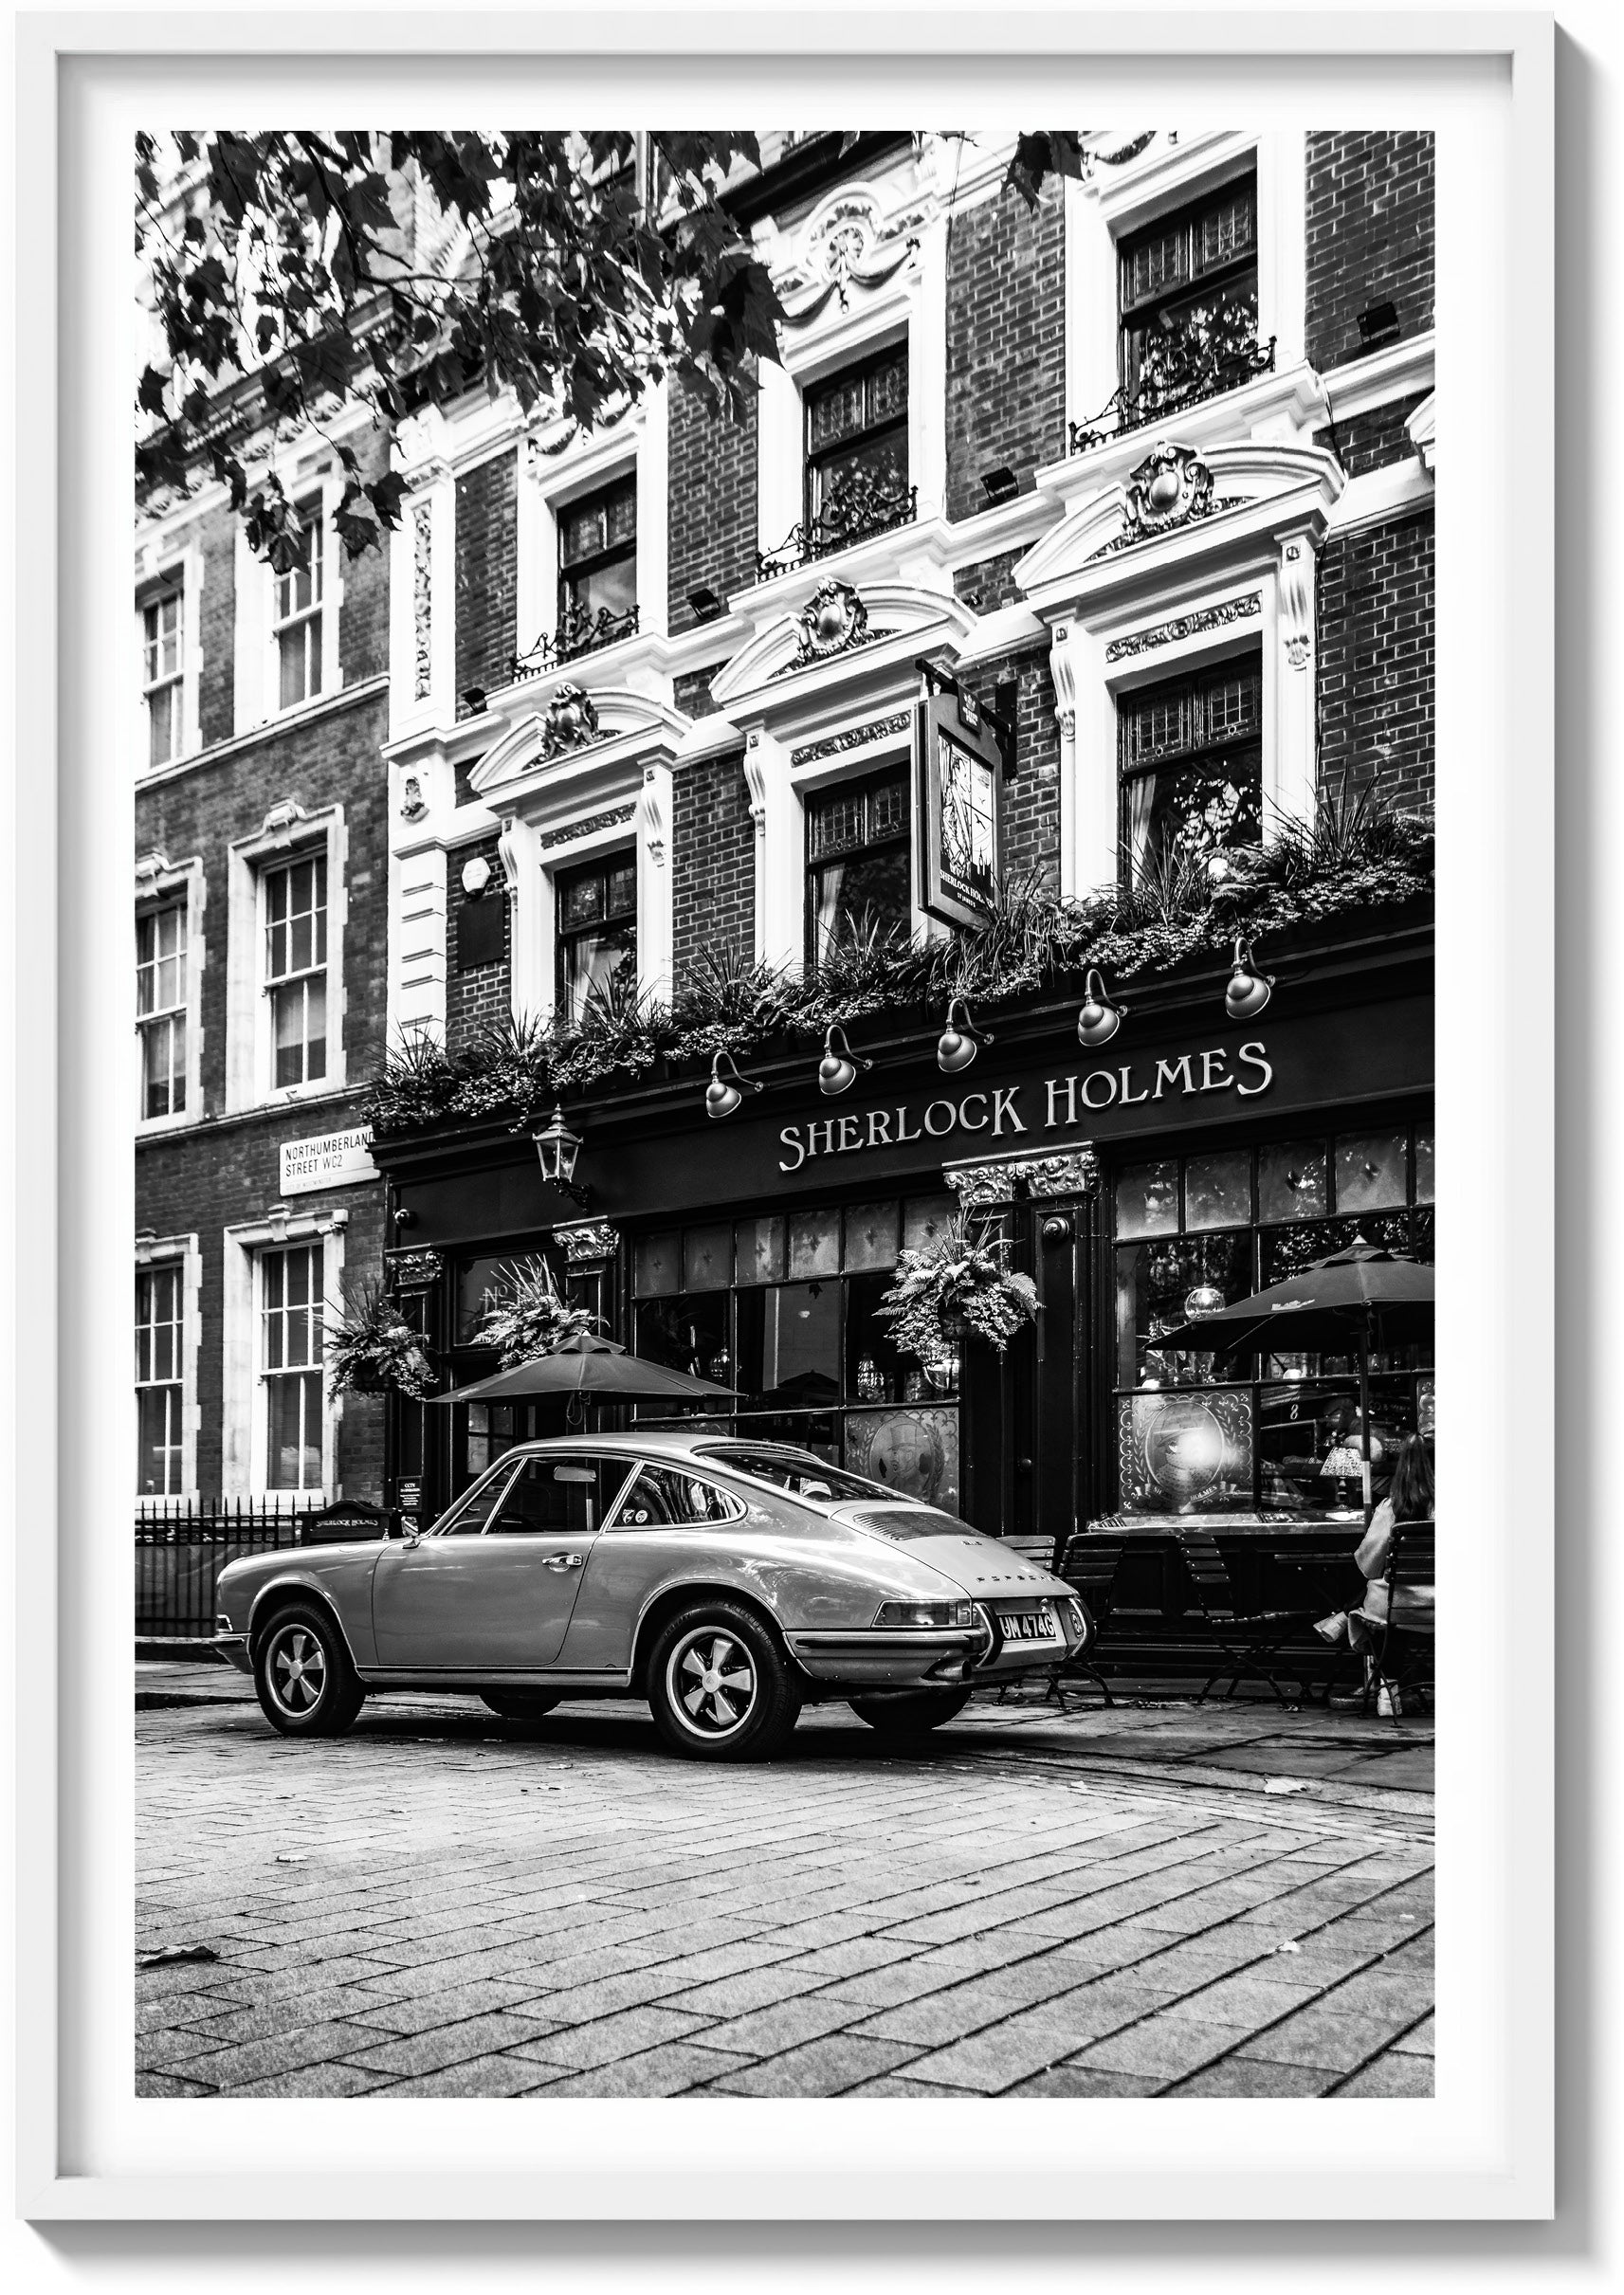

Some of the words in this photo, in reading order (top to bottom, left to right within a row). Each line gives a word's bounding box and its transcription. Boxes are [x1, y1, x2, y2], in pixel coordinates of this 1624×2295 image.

[779, 1086, 1028, 1172] SHERLOCK
[1045, 1042, 1273, 1127] HOLMES
[285, 1132, 374, 1161] NORTHUMBERLAND
[285, 1158, 319, 1177] STREET
[322, 1155, 343, 1170] WC2
[998, 1615, 1022, 1639] UM
[1022, 1614, 1055, 1638] 474G
